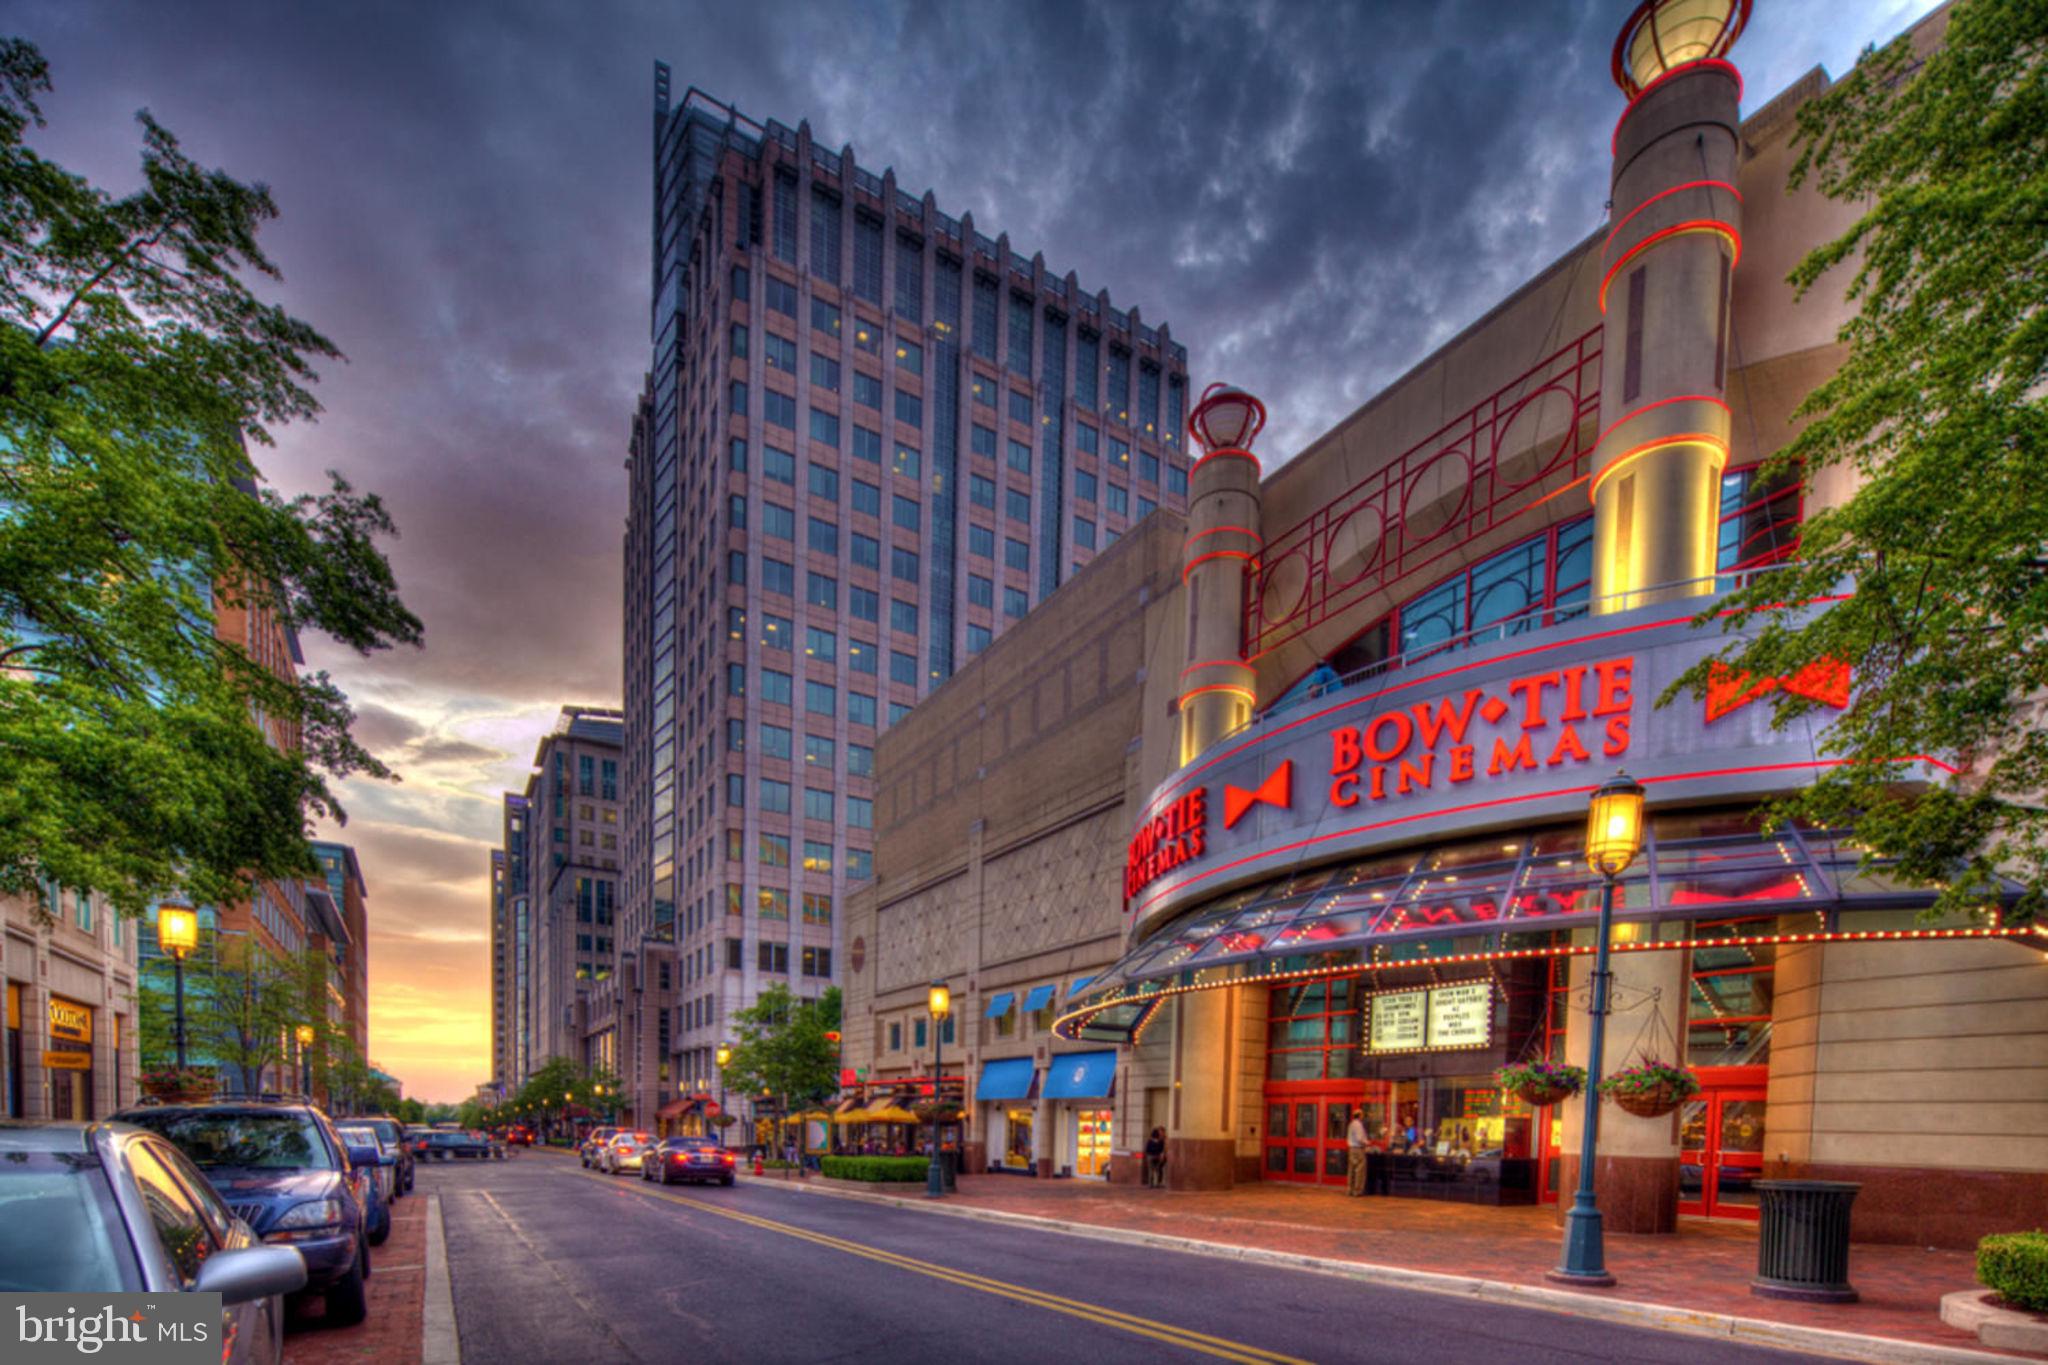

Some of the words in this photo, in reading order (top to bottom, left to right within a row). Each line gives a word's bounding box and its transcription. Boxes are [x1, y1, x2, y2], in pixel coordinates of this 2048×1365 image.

[1329, 688, 1484, 777] BOW
[1508, 656, 1635, 730] TIE
[1329, 715, 1631, 808] CINEMAS
[1163, 786, 1206, 842] TIE
